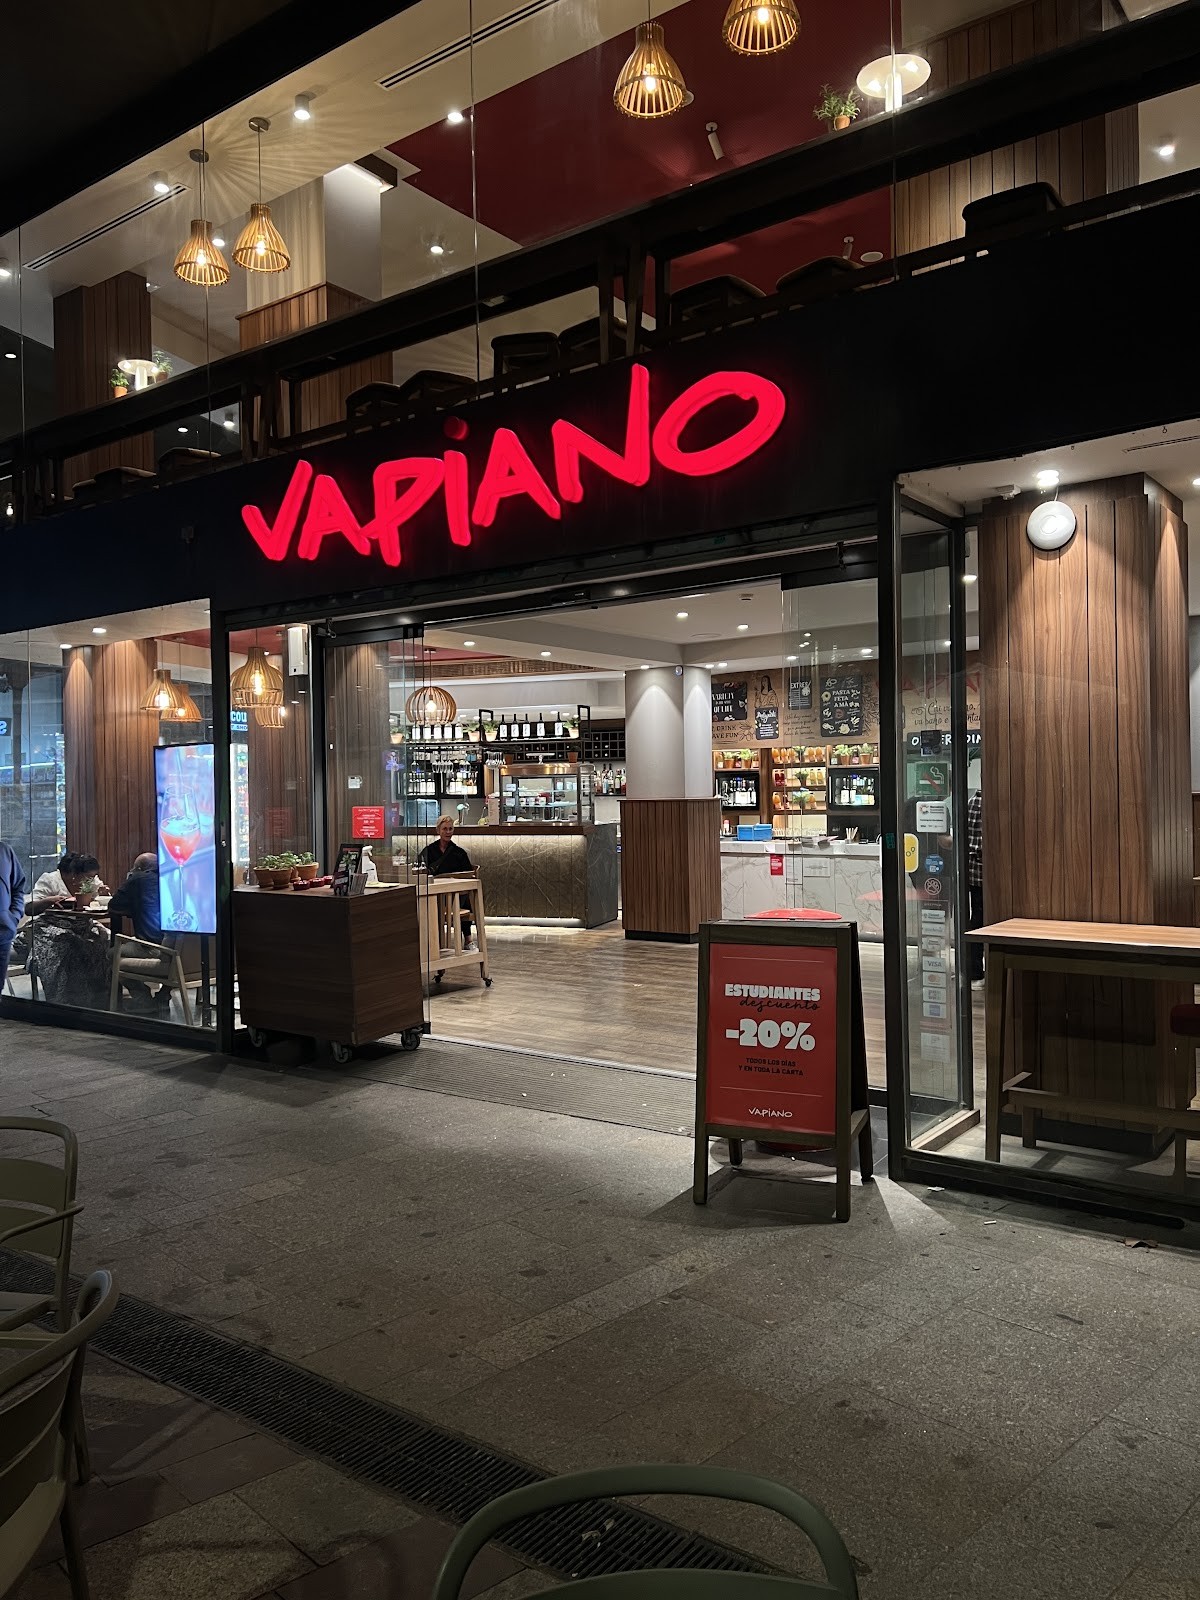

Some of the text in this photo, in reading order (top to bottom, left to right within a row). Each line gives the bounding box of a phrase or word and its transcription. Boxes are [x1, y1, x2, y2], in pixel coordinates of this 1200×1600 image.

[927, 960, 943, 968] VISA
[725, 983, 821, 1001] ESTUDIANTES
[740, 996, 821, 1012] descuento
[725, 1018, 816, 1051] -20%
[746, 1057, 766, 1065] TODOS
[768, 1058, 780, 1066] LOS
[748, 1107, 793, 1118] VAPIANO
